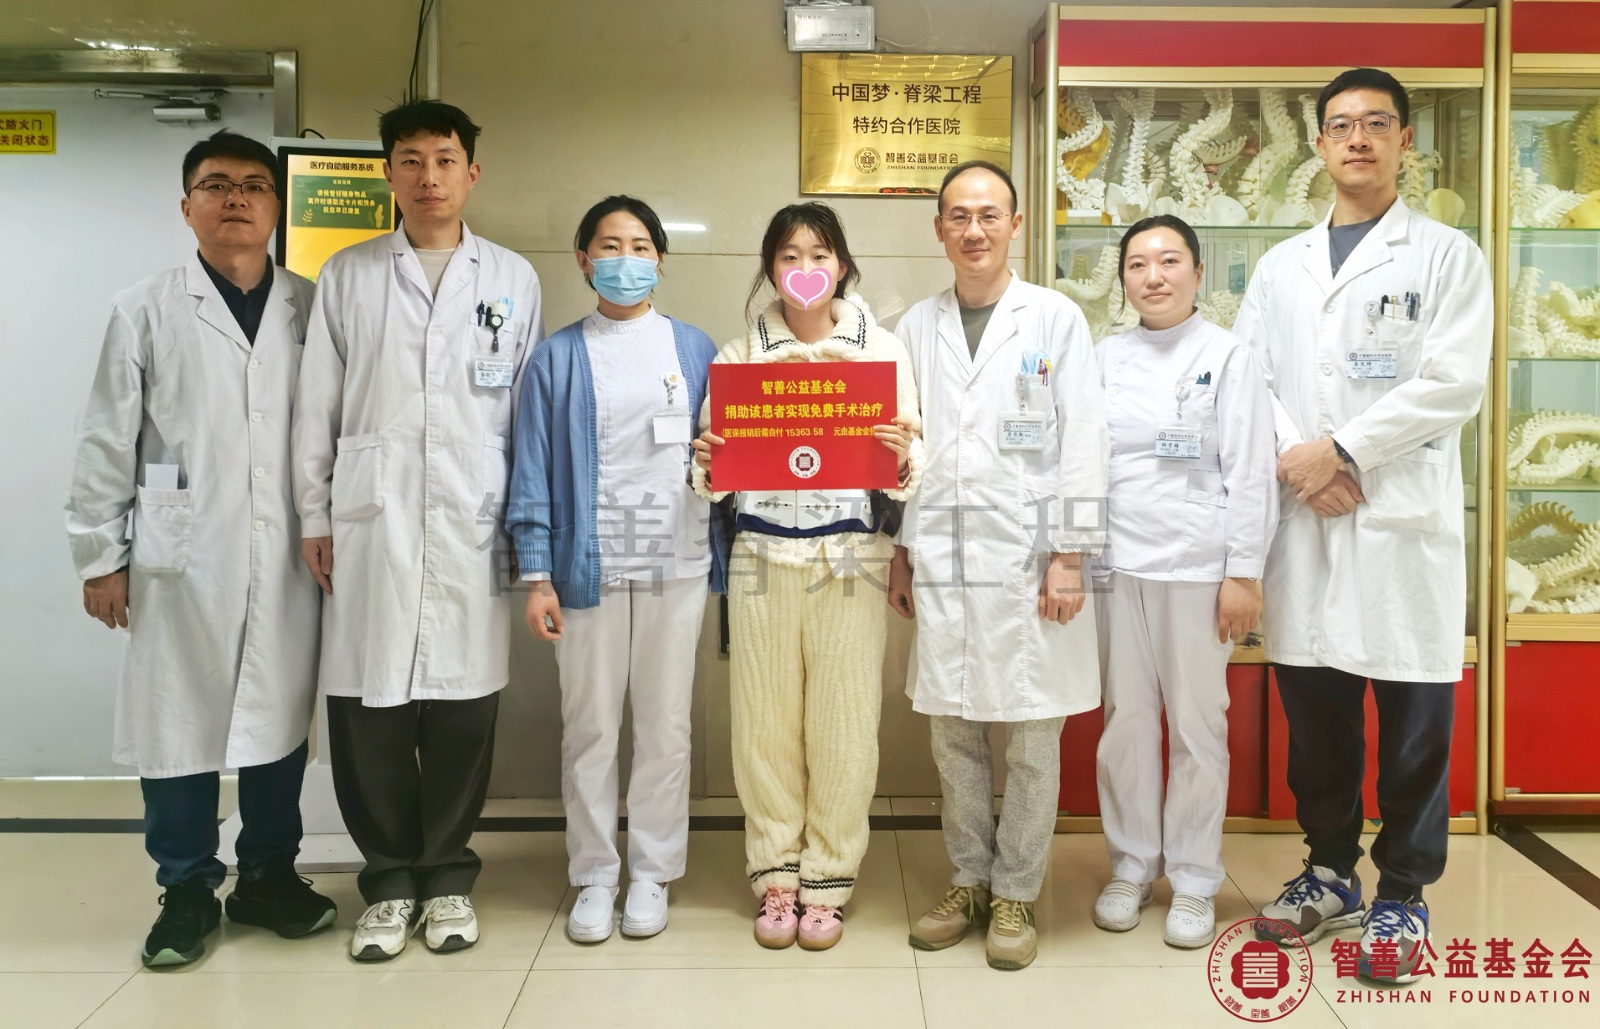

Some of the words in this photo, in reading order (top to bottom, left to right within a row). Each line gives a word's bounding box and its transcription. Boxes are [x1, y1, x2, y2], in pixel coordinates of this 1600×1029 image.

[832, 83, 982, 104] 中国梦·脊梁工程
[852, 116, 961, 135] 特约合作医院
[310, 161, 374, 171] 医疗自助服务系统
[885, 152, 959, 164] 智善公益基金会
[761, 379, 847, 395] 智善公益基金会
[725, 402, 883, 419] 捐助该患者实现免费手术治疗
[785, 428, 824, 437] 15363.58
